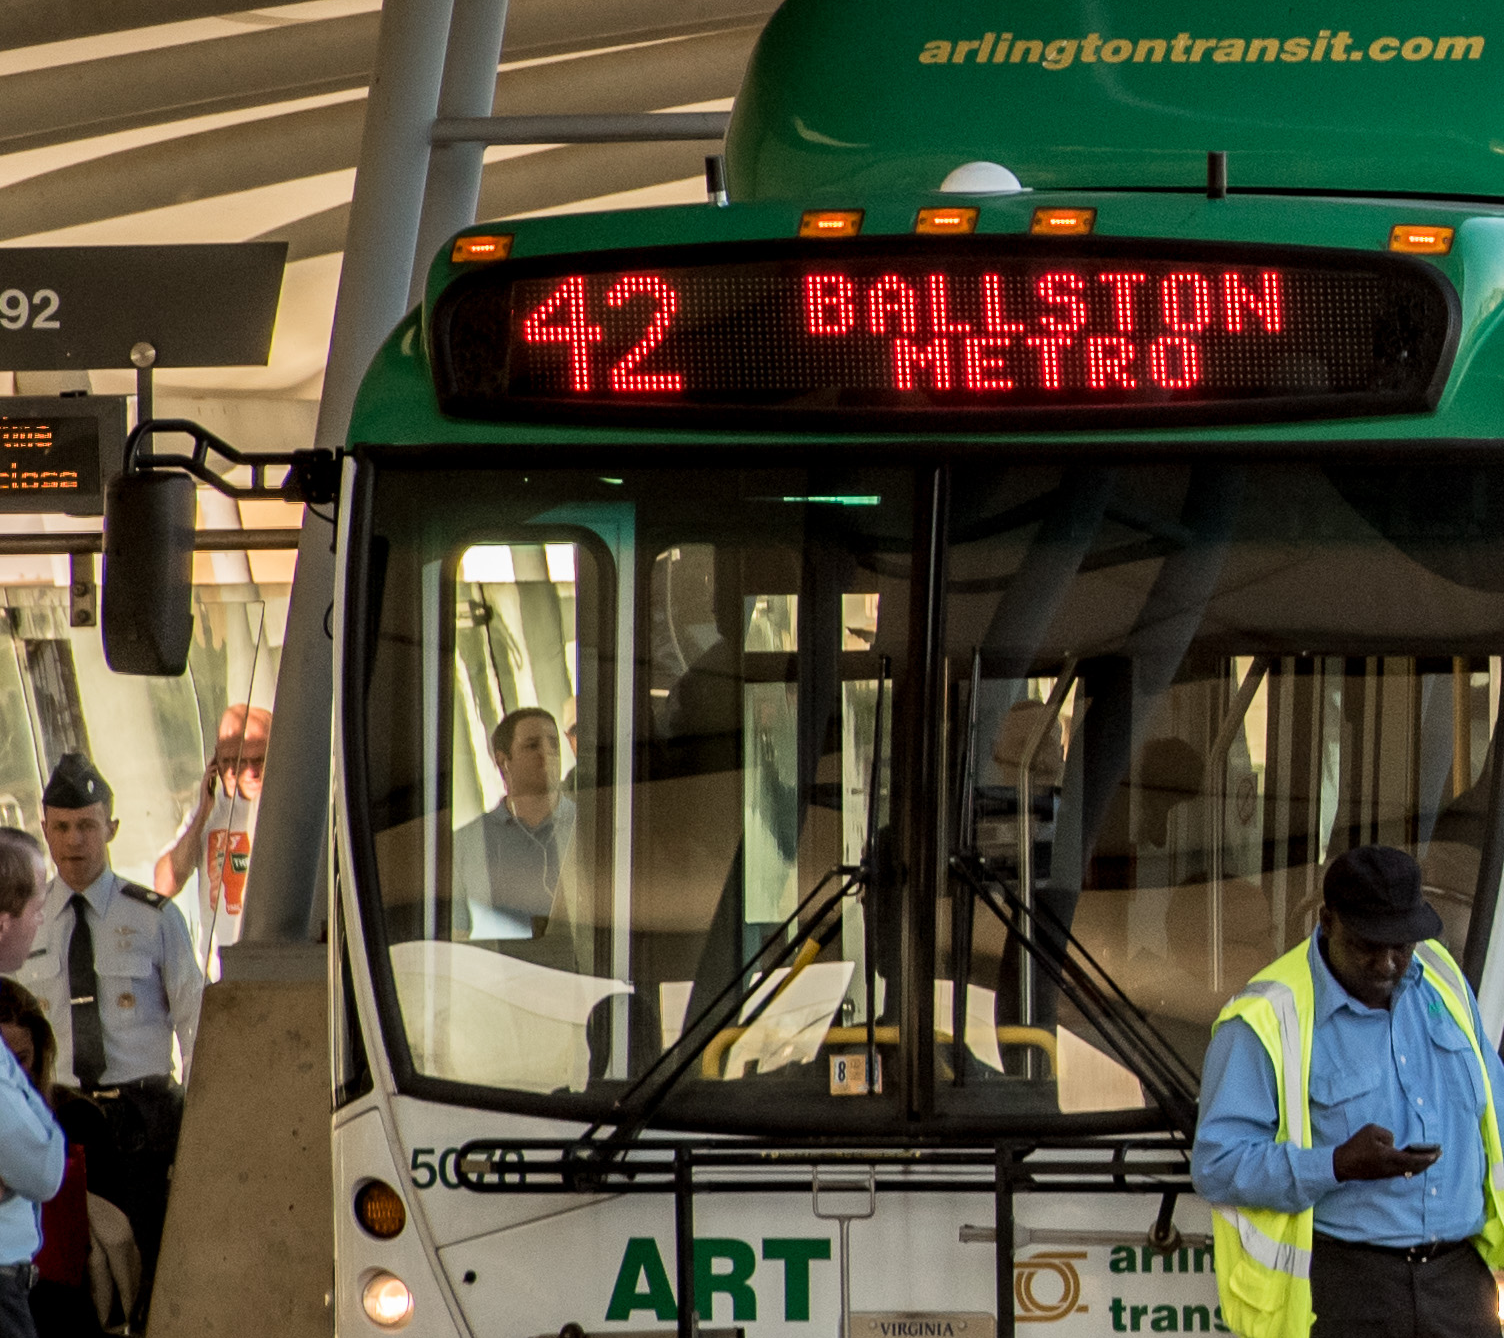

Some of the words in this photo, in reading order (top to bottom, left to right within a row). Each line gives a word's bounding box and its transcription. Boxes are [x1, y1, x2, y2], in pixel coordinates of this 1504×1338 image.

[919, 30, 1485, 71] arlingtontransit.com
[523, 274, 684, 394] 42
[802, 270, 1286, 337] BALLSTON
[894, 335, 1201, 393] METRO
[604, 1237, 832, 1321] ART
[880, 1321, 954, 1337] VIRGINIA
[1109, 1297, 1231, 1332] trans
